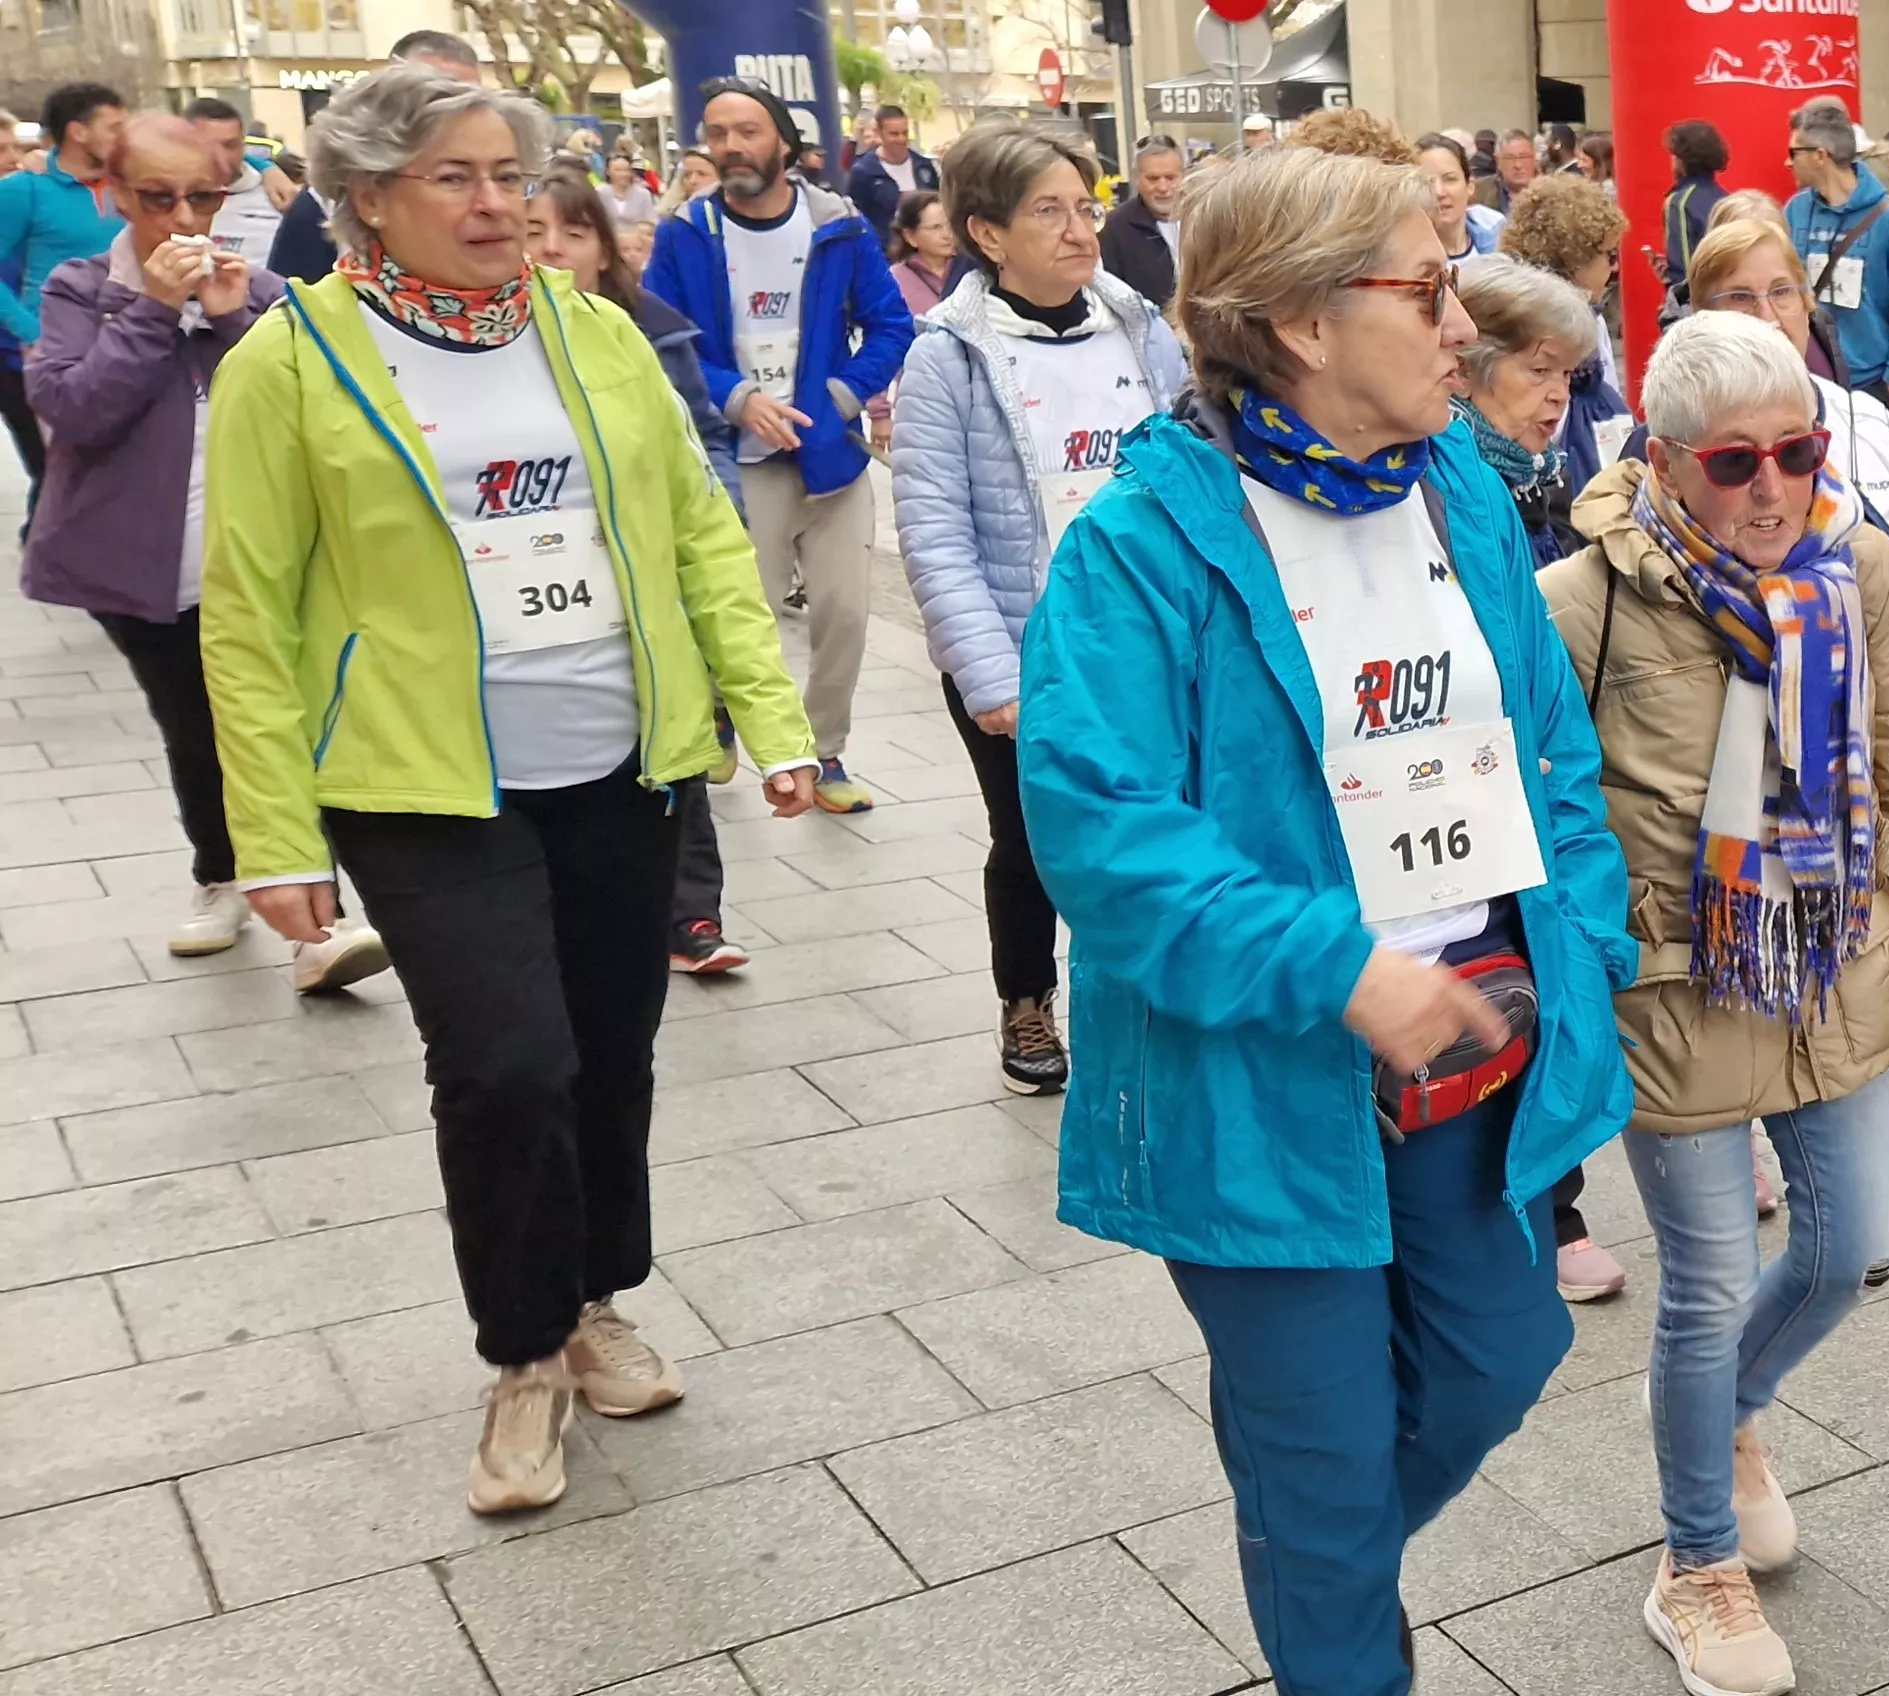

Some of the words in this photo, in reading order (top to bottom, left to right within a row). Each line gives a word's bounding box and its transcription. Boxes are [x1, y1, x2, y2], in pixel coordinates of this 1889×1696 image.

[1160, 88, 1201, 113] GED
[1206, 87, 1261, 112] SPOTS
[751, 363, 787, 382] 154
[474, 455, 573, 517] R091
[517, 578, 593, 618] 304
[1354, 650, 1451, 738] R091
[1389, 819, 1472, 873] 116
